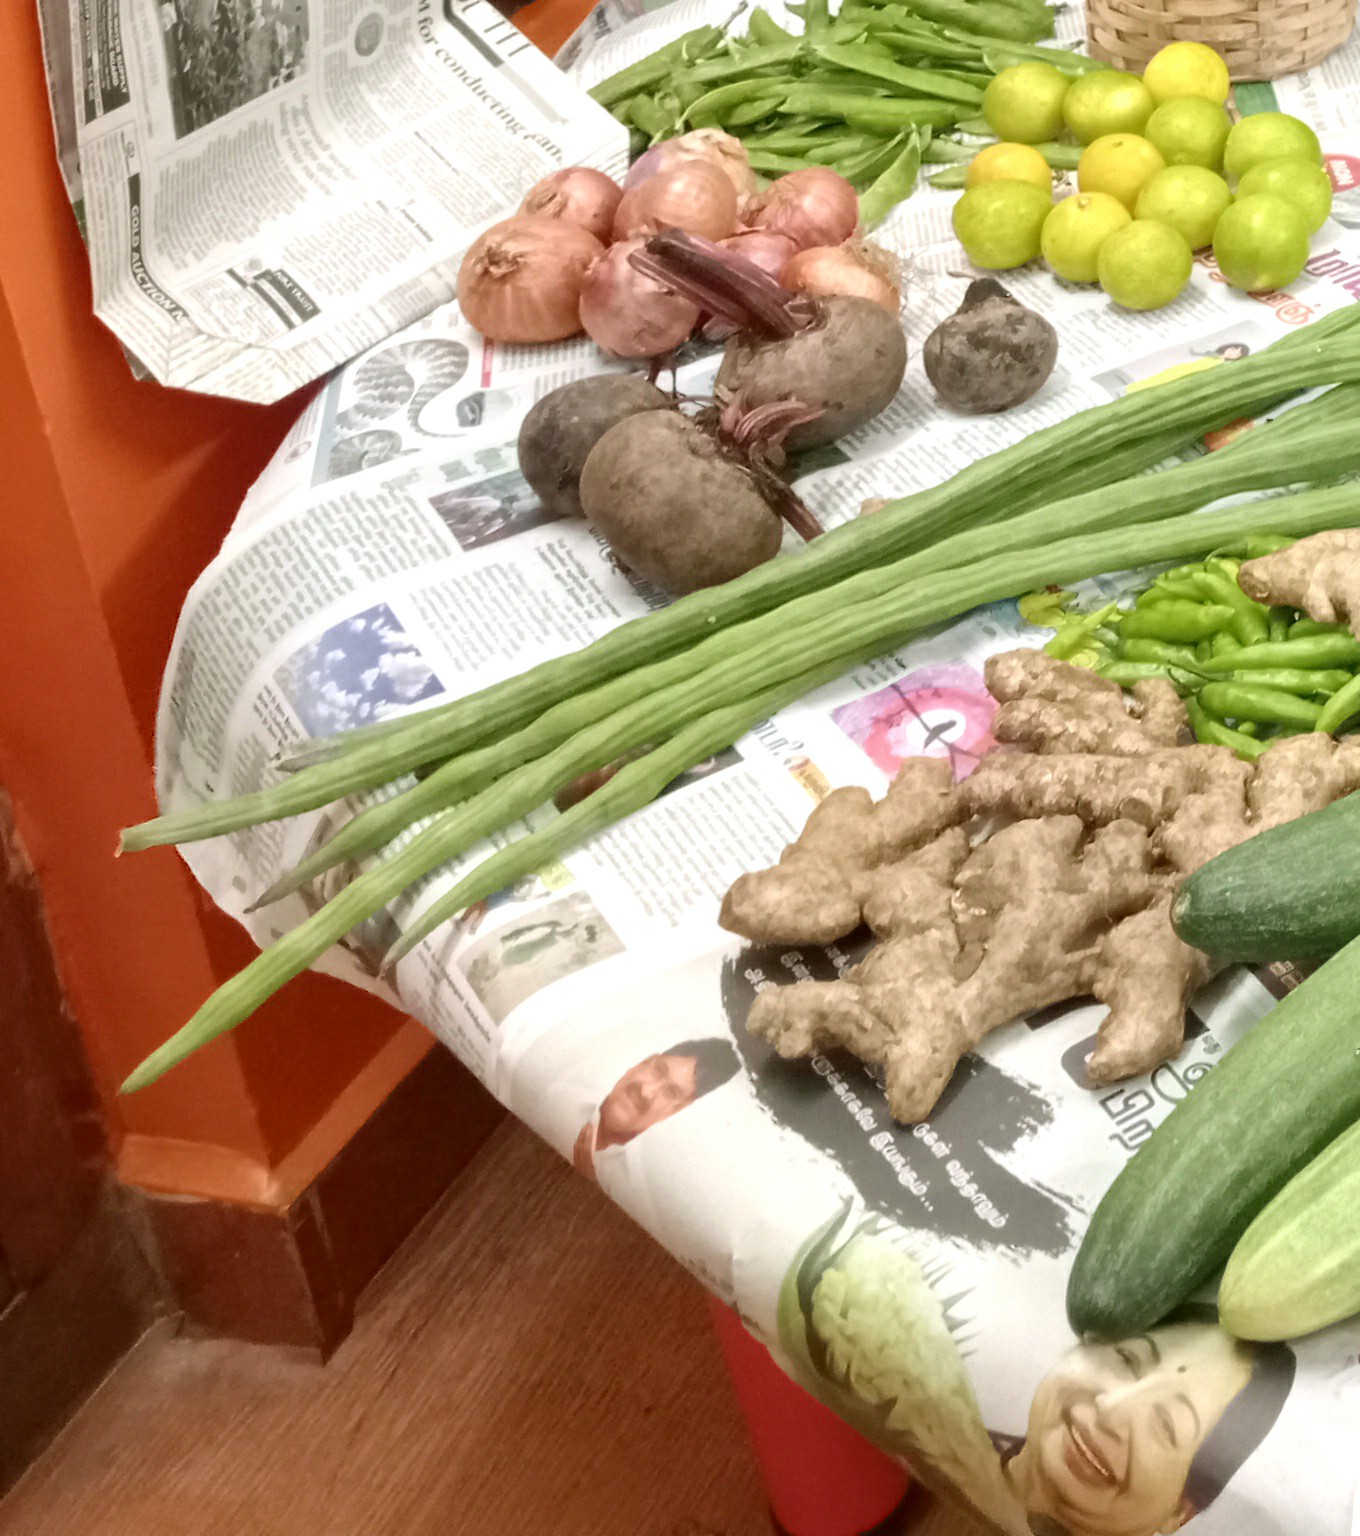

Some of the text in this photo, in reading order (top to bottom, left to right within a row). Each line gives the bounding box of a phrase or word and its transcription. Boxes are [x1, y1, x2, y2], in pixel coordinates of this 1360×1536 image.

[414, 15, 442, 51] for
[434, 44, 525, 135] conducting
[121, 204, 175, 314] GOLD AUCTION
